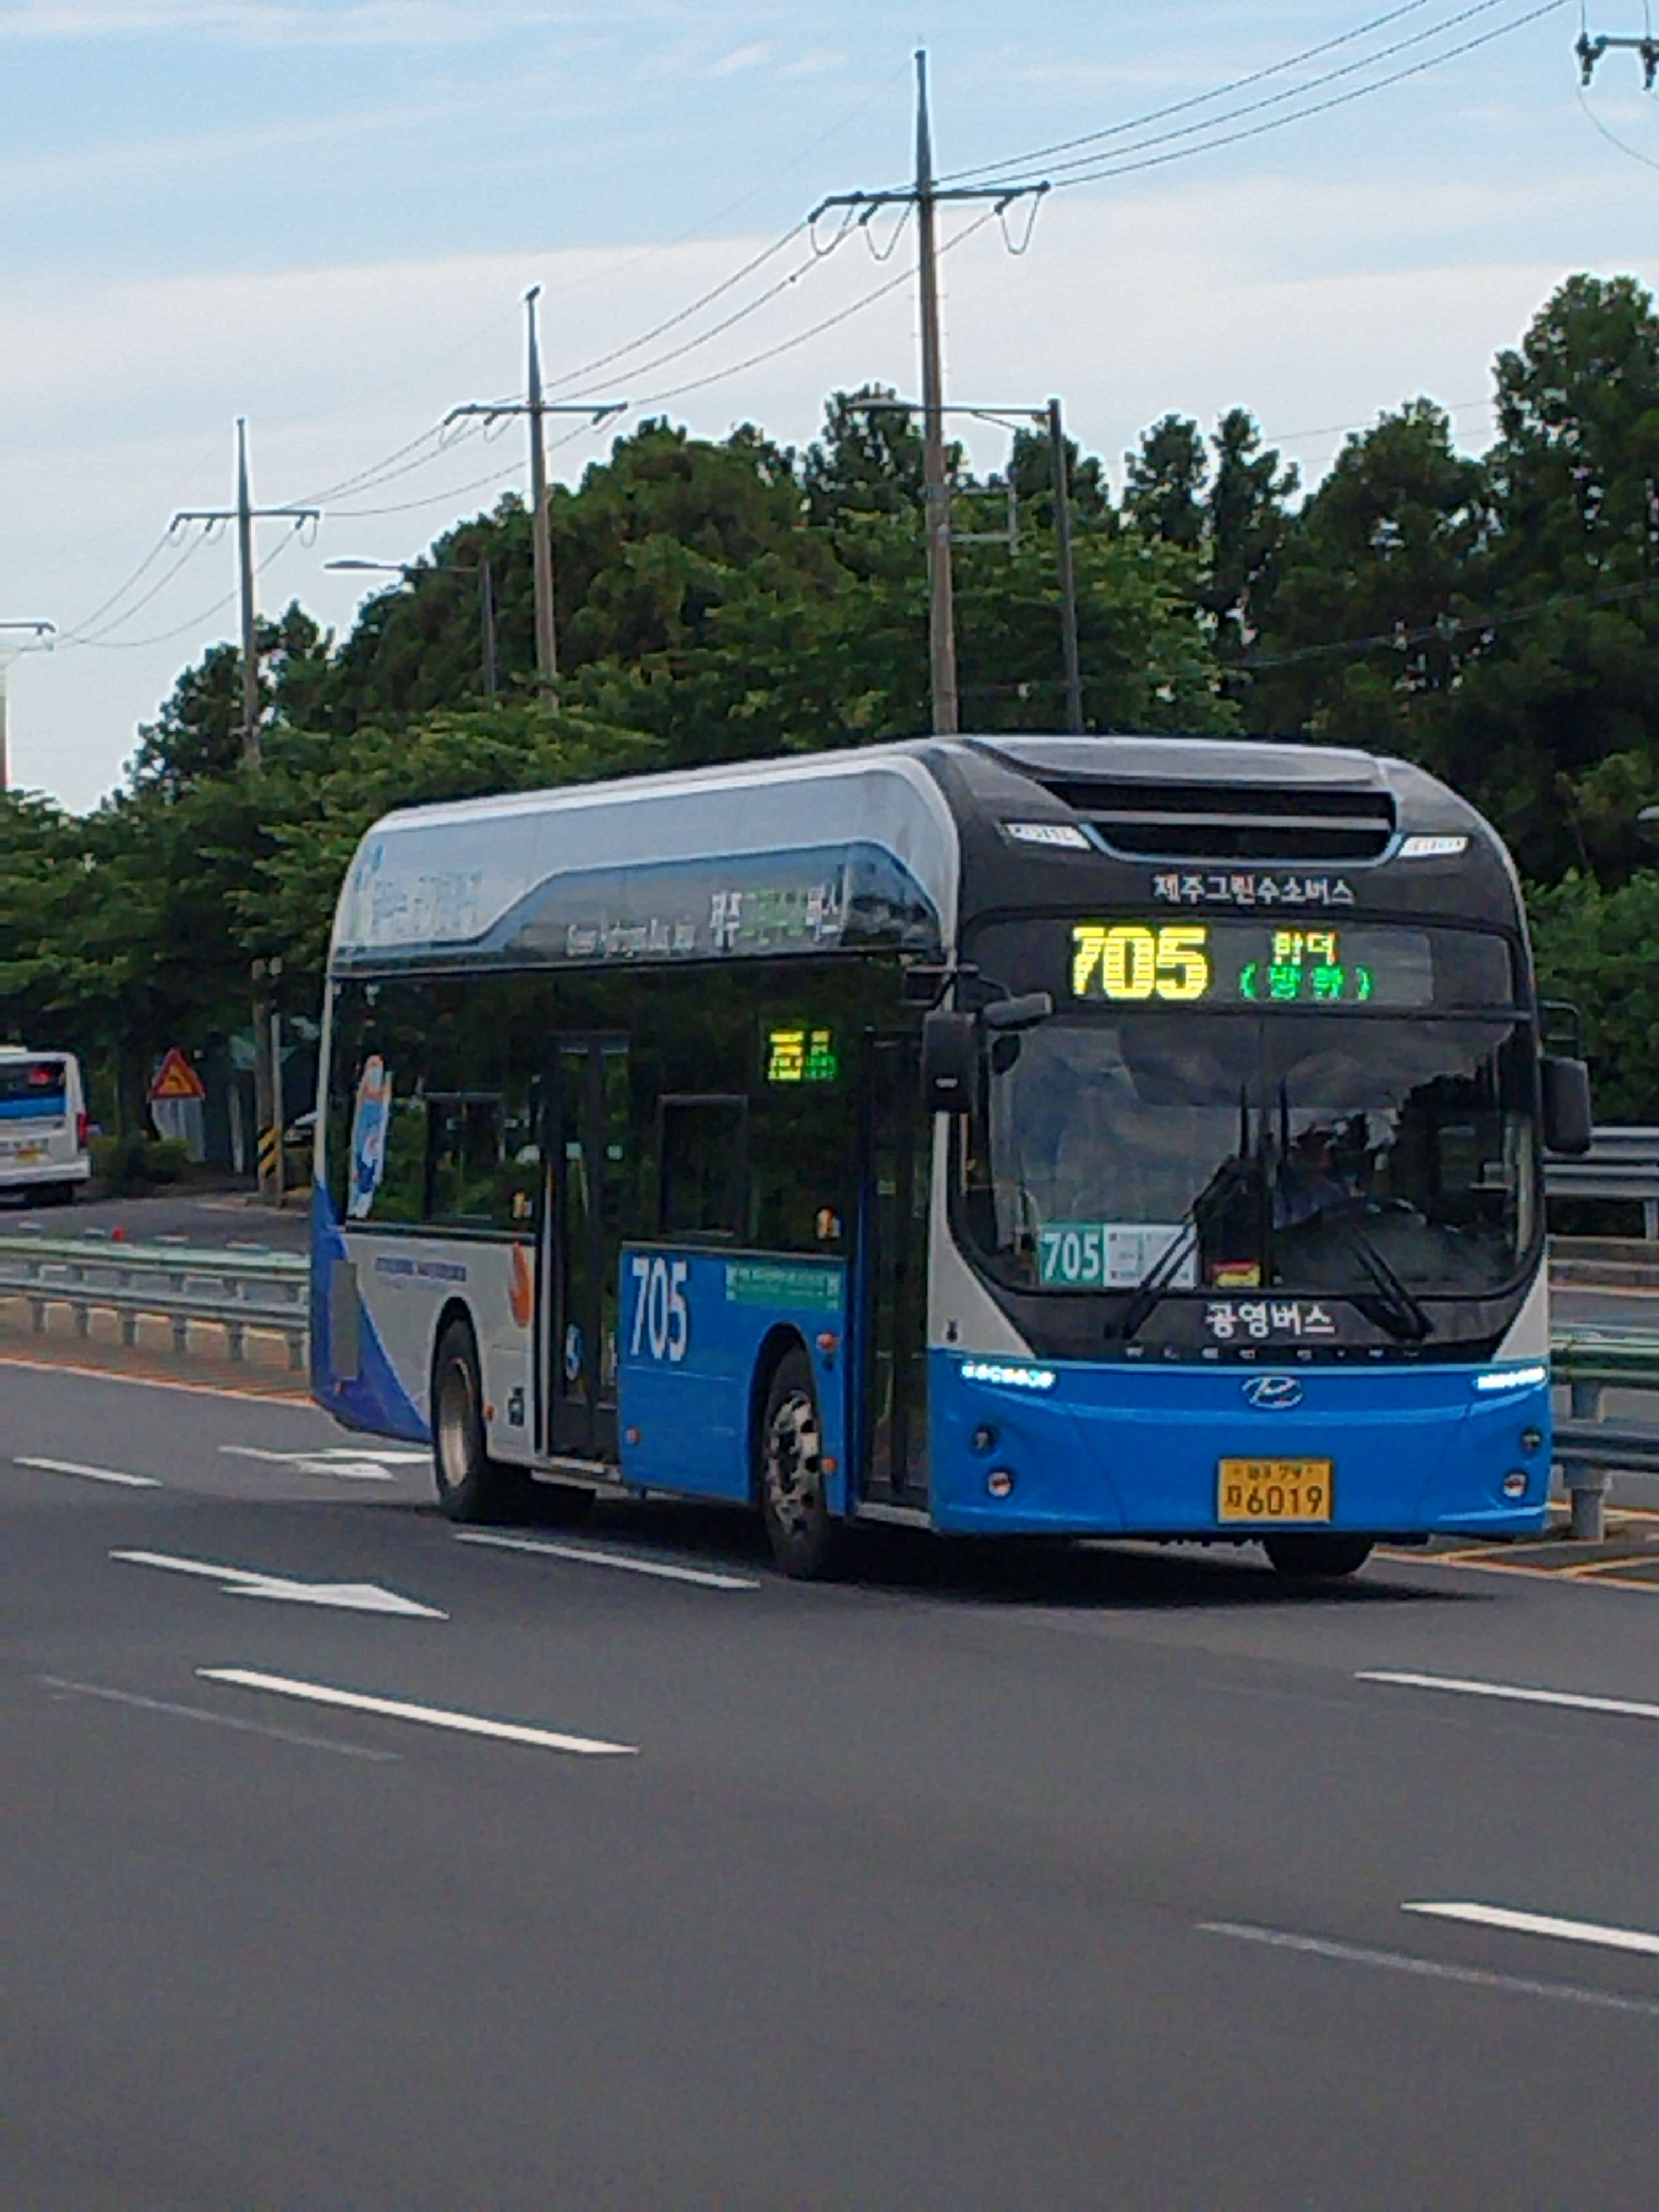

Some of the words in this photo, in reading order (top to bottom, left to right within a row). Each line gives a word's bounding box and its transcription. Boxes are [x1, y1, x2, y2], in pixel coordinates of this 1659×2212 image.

[1153, 873, 1355, 905] 제주그린수소버스
[1073, 927, 1208, 1000] 705
[1043, 1231, 1102, 1280] 705
[630, 1256, 687, 1361] 705
[1204, 1301, 1335, 1338] 공영버스
